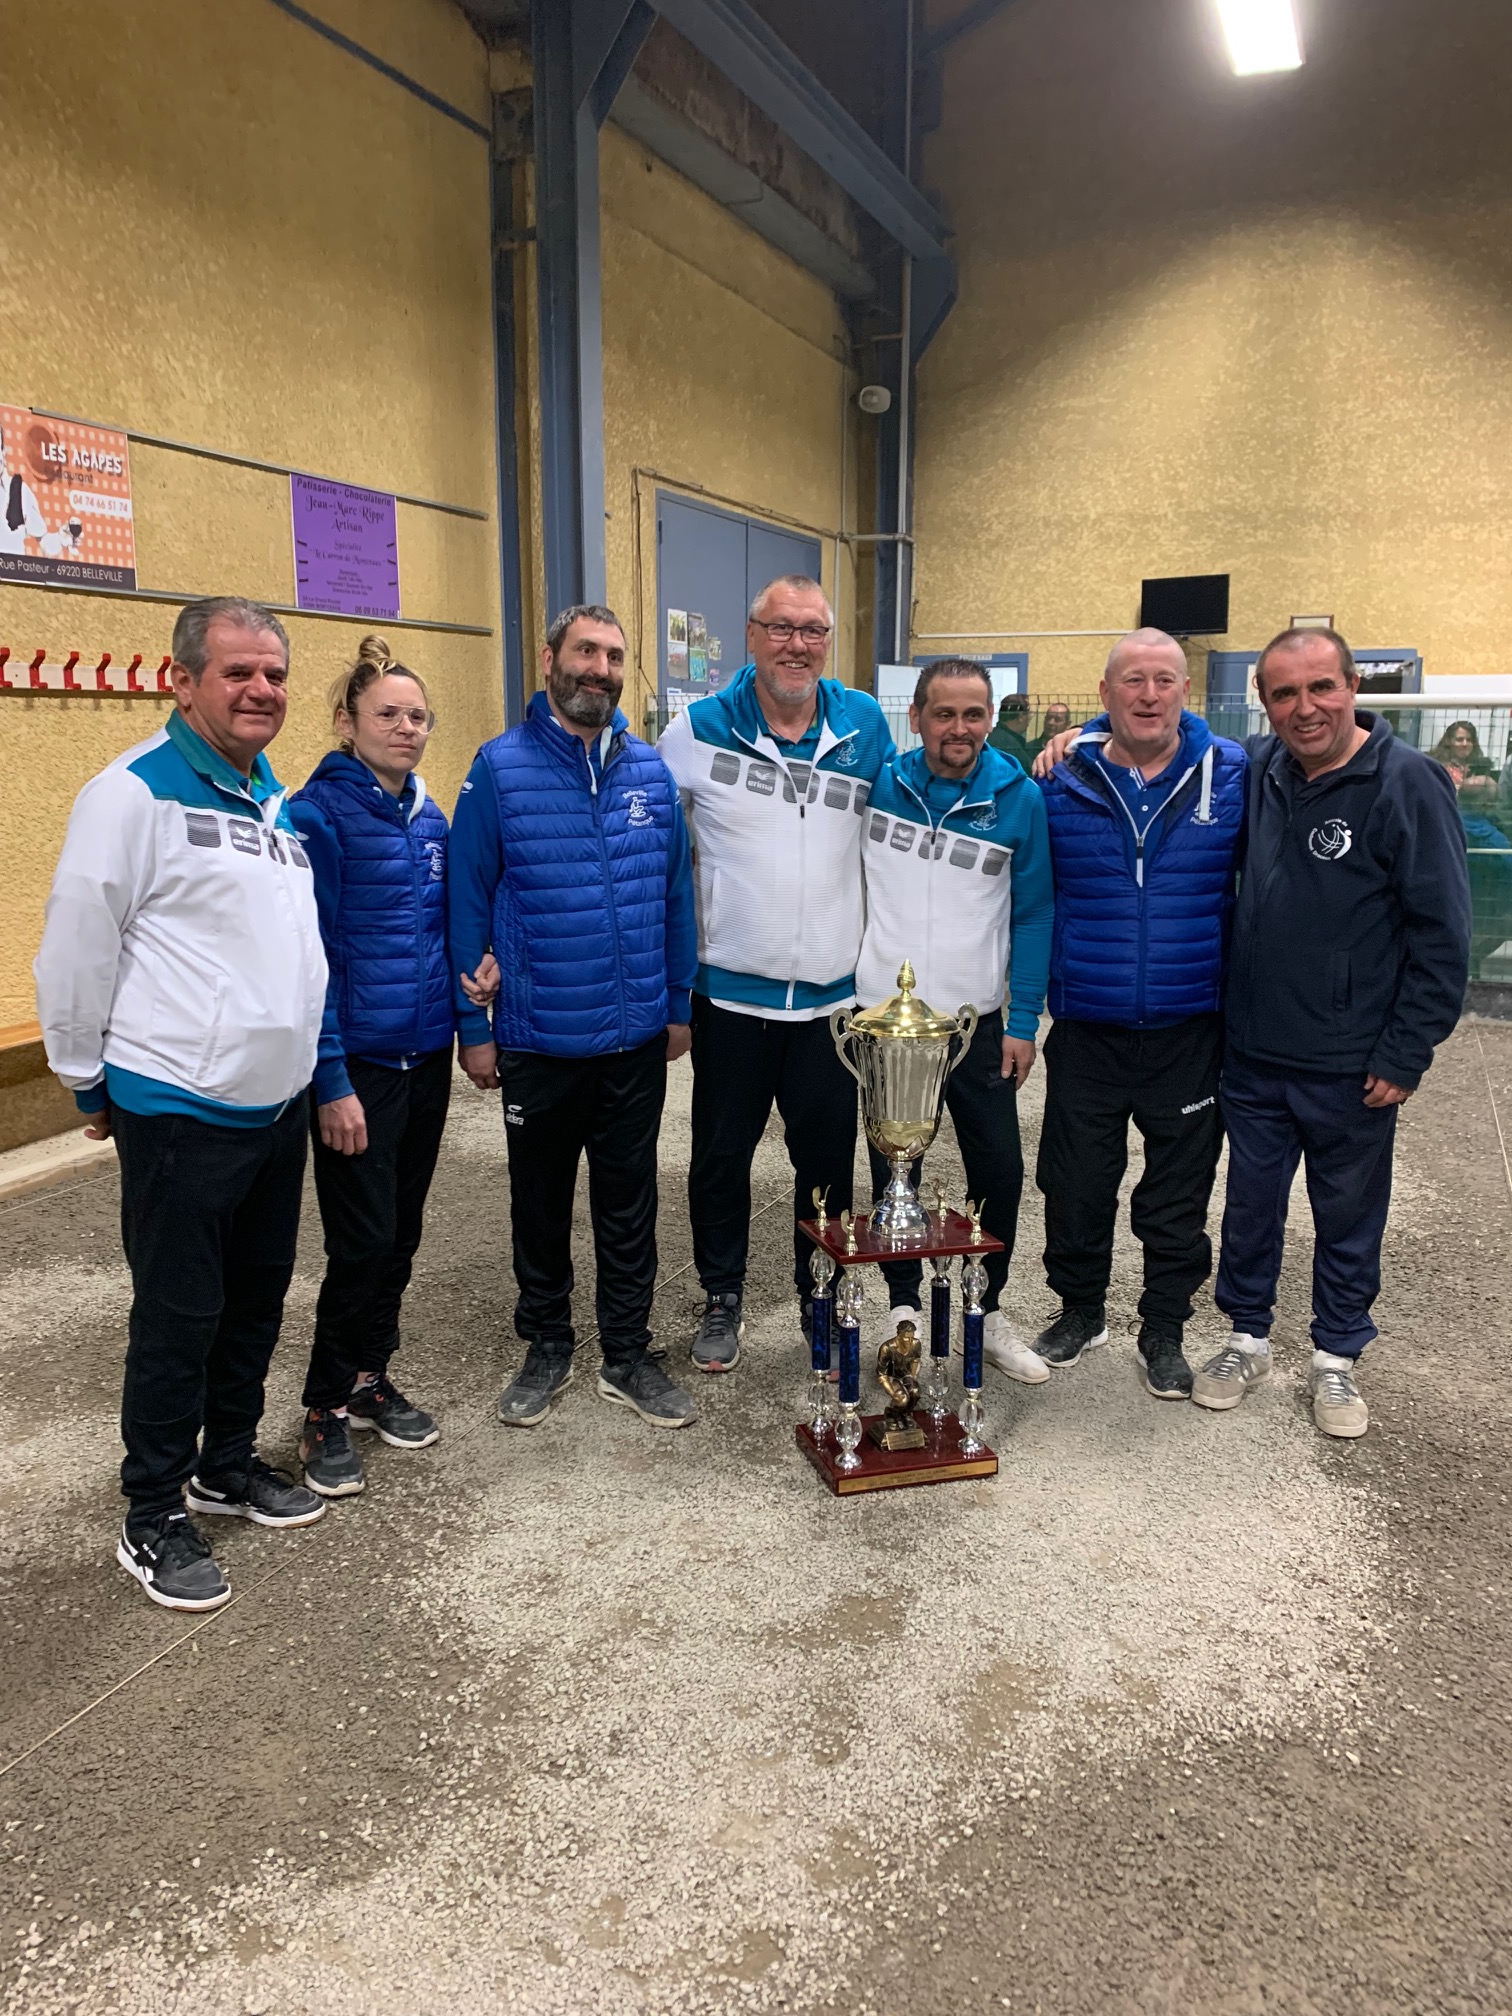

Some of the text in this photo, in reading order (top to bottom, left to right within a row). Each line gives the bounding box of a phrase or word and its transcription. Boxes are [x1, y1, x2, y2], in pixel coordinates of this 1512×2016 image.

[41, 441, 122, 474] LES AGAPES
[296, 477, 338, 495] Patisserie
[344, 488, 391, 507] Chocolaterie
[73, 494, 128, 513] 04 74 66 51 74
[331, 518, 363, 533] Artisan
[17, 559, 50, 574] Pasteur
[57, 564, 80, 577] 69220
[82, 568, 123, 582] BELLEVILLE
[747, 780, 774, 793] erima
[232, 838, 260, 851] erima
[1181, 1095, 1215, 1114] uhlsport
